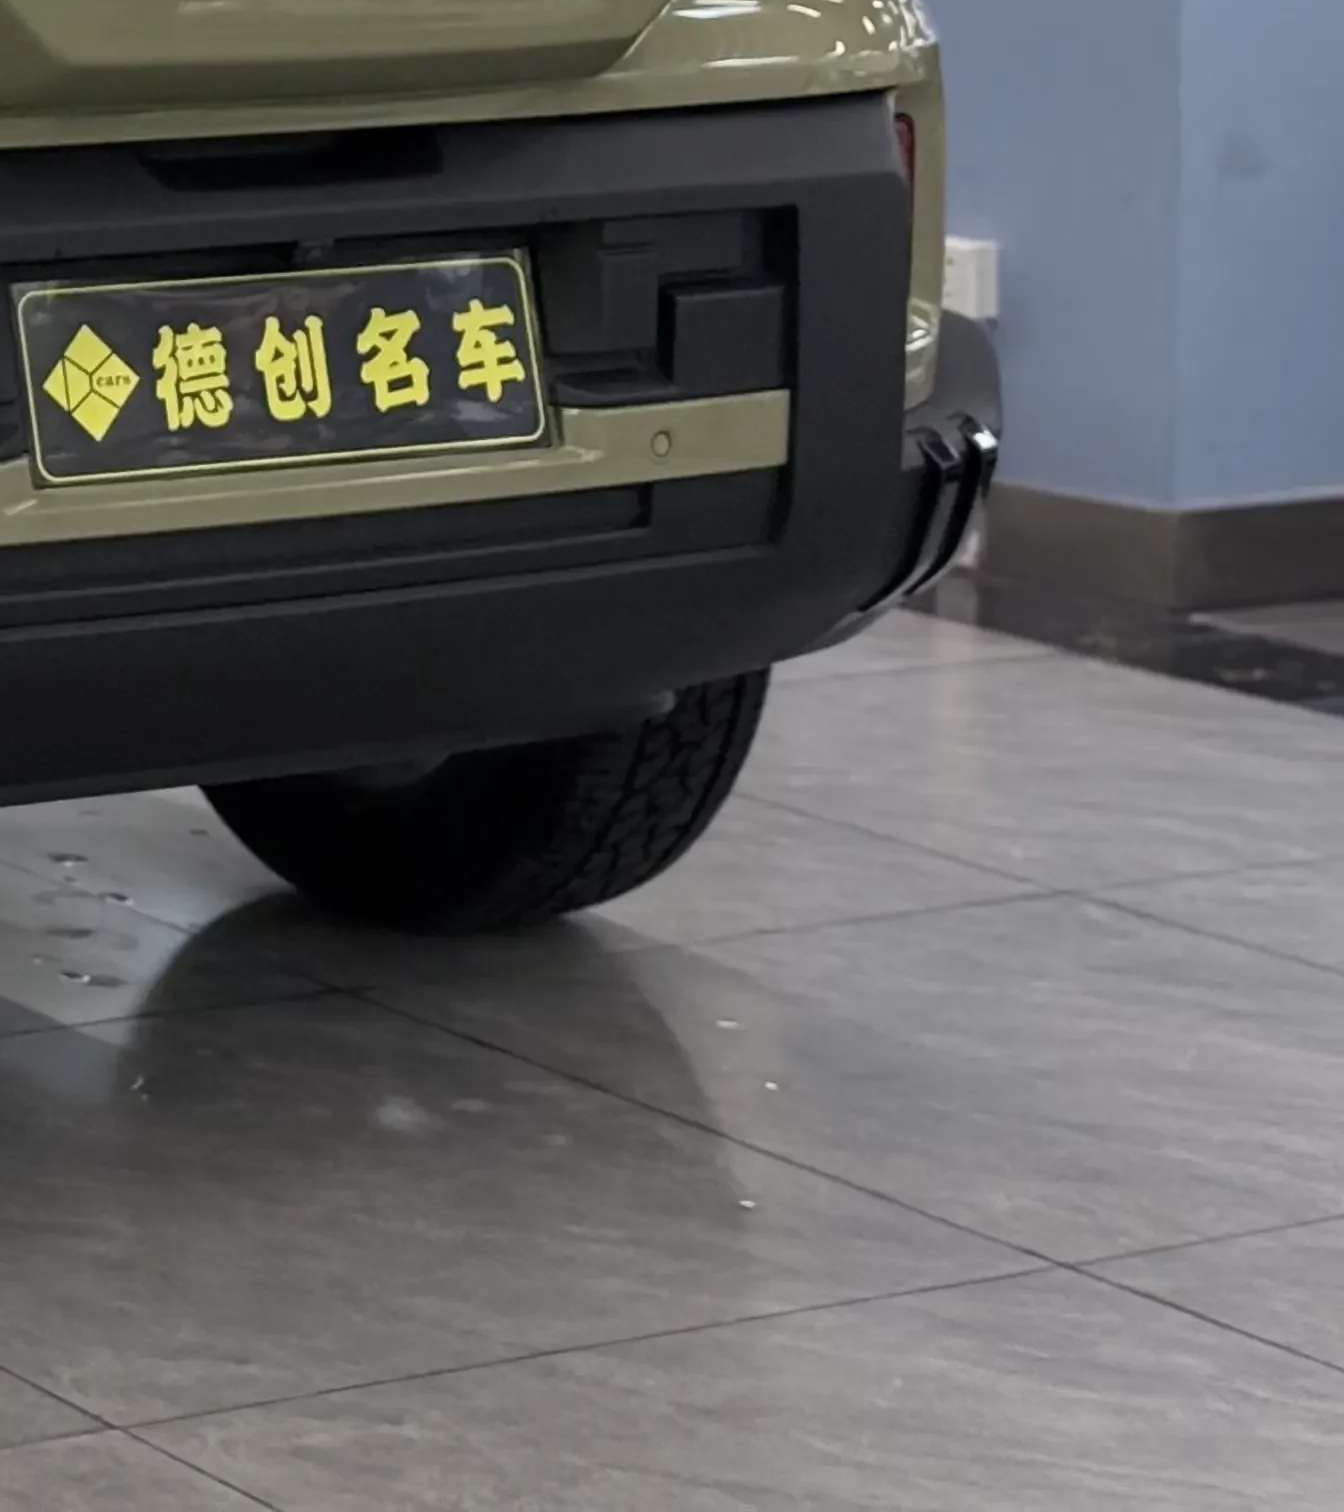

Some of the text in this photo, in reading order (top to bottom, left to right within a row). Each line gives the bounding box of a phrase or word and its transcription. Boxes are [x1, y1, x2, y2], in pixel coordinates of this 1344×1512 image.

[96, 375, 131, 387] cars
[152, 299, 526, 431] 德创名车
